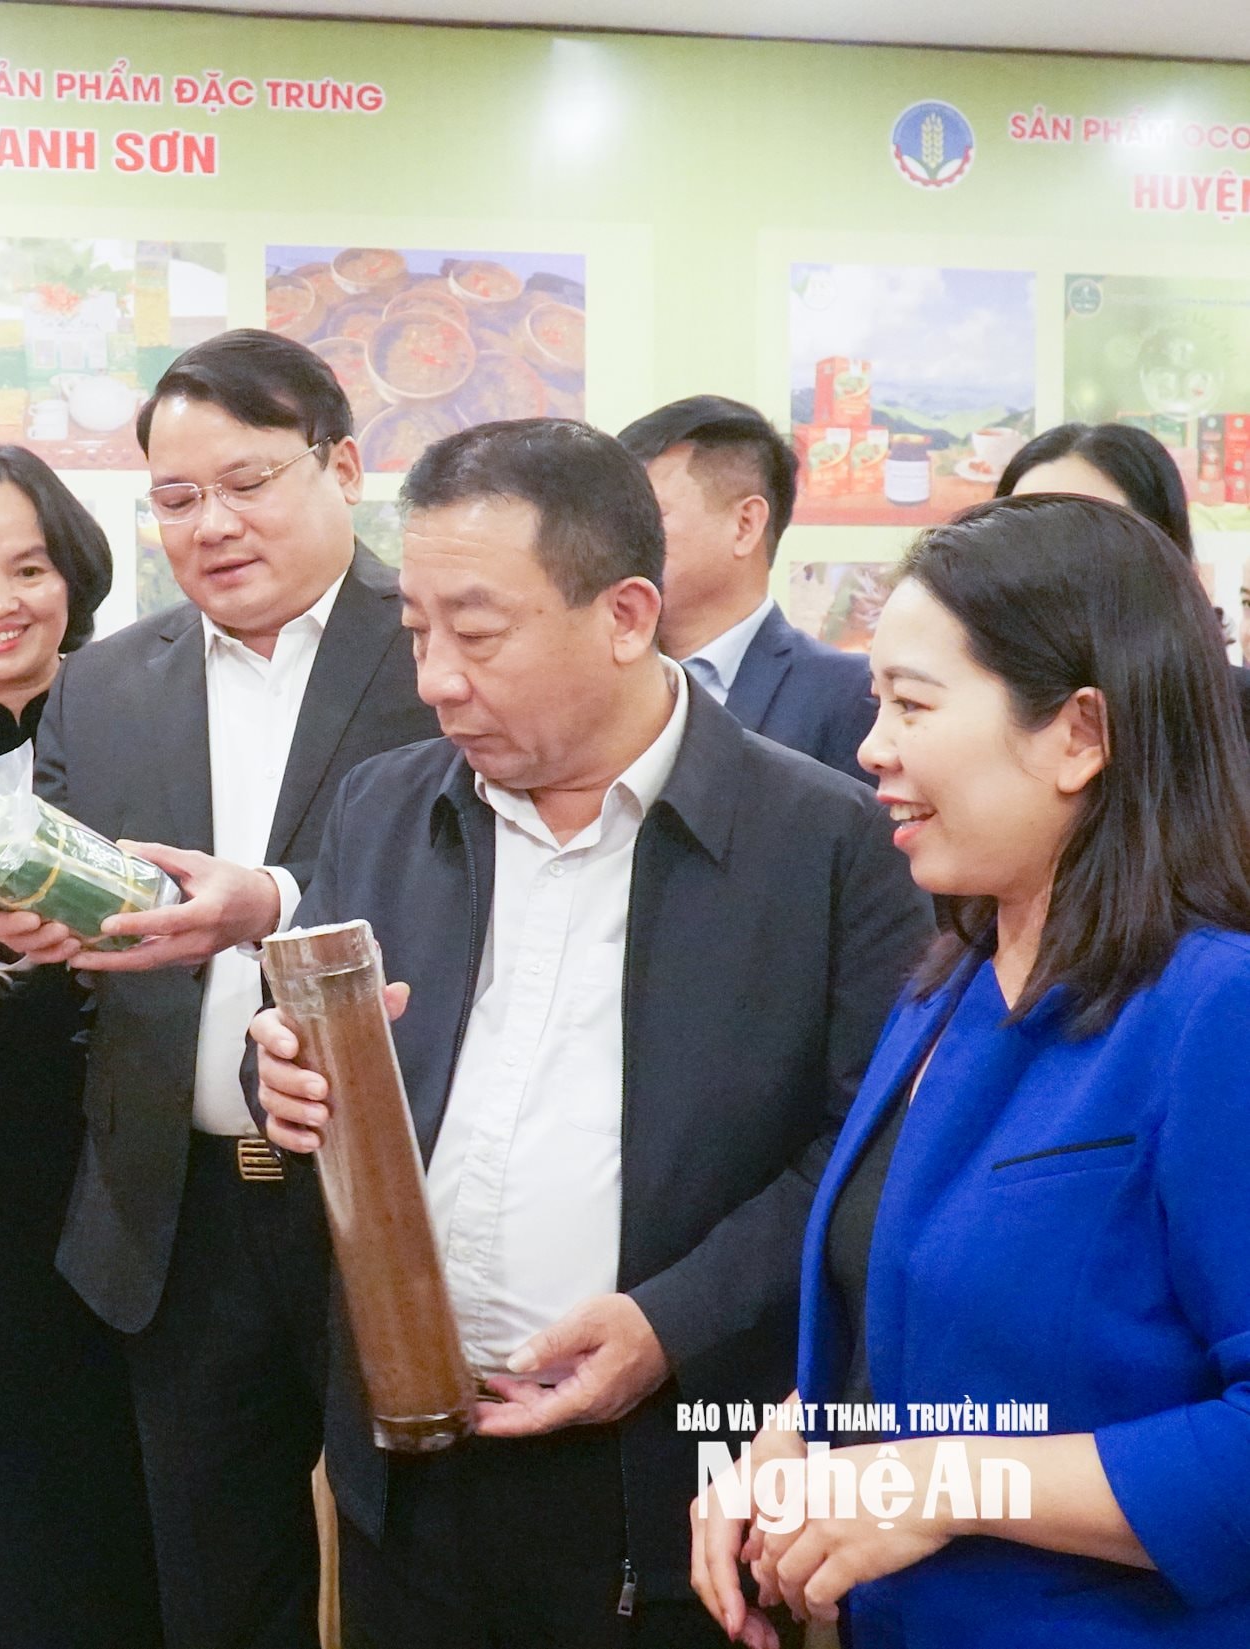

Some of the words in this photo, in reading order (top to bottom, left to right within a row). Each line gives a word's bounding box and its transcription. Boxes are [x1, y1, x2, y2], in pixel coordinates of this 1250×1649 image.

[56, 59, 161, 103] PHẨM
[174, 72, 255, 113] ĐẶC
[266, 77, 384, 112] TRƯNG
[1009, 106, 1072, 141] SẢN
[114, 130, 217, 175] SƠN
